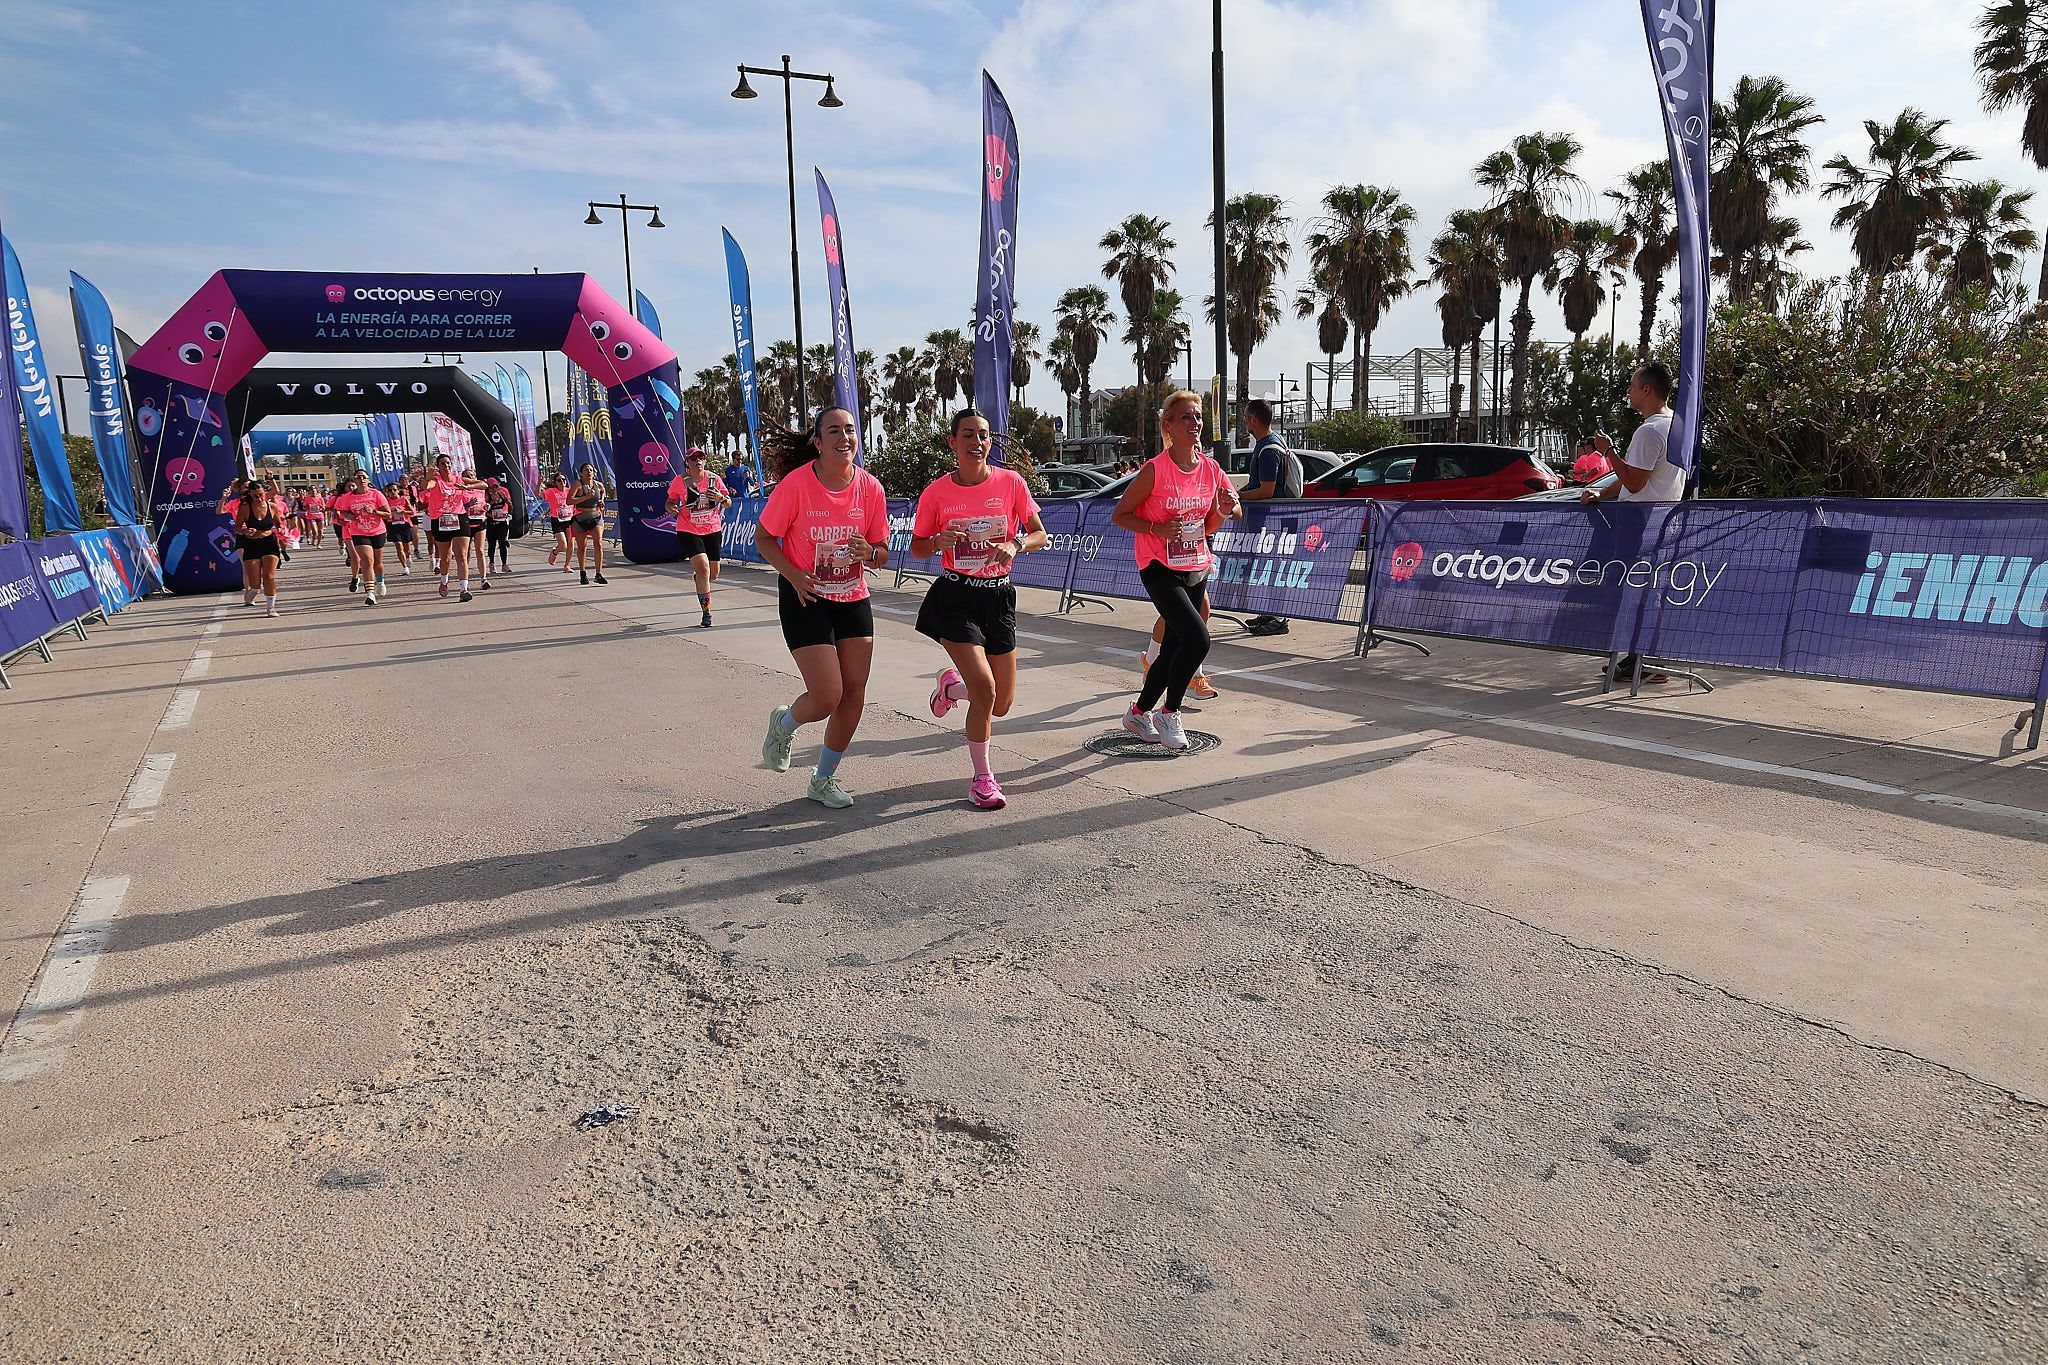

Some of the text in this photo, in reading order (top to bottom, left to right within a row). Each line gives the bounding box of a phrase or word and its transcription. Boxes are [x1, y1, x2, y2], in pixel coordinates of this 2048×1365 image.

[316, 311, 512, 326] LA ENERGÍA PARA CORRER
[315, 328, 516, 339] A LA VELOCIDAD DE LA LUZ
[277, 382, 428, 396] VOLVO
[194, 500, 220, 508] ener
[1166, 497, 1207, 510] CARRERA
[720, 501, 757, 555] arlene
[1053, 533, 1103, 561] energy
[1212, 526, 1298, 555] anzado la
[942, 570, 960, 582] RO
[1222, 558, 1248, 584] DE
[1249, 559, 1273, 586] LA
[1274, 560, 1314, 589] LUZ
[1432, 549, 1728, 607] octopus energy
[964, 576, 1010, 588] NIKE PR
